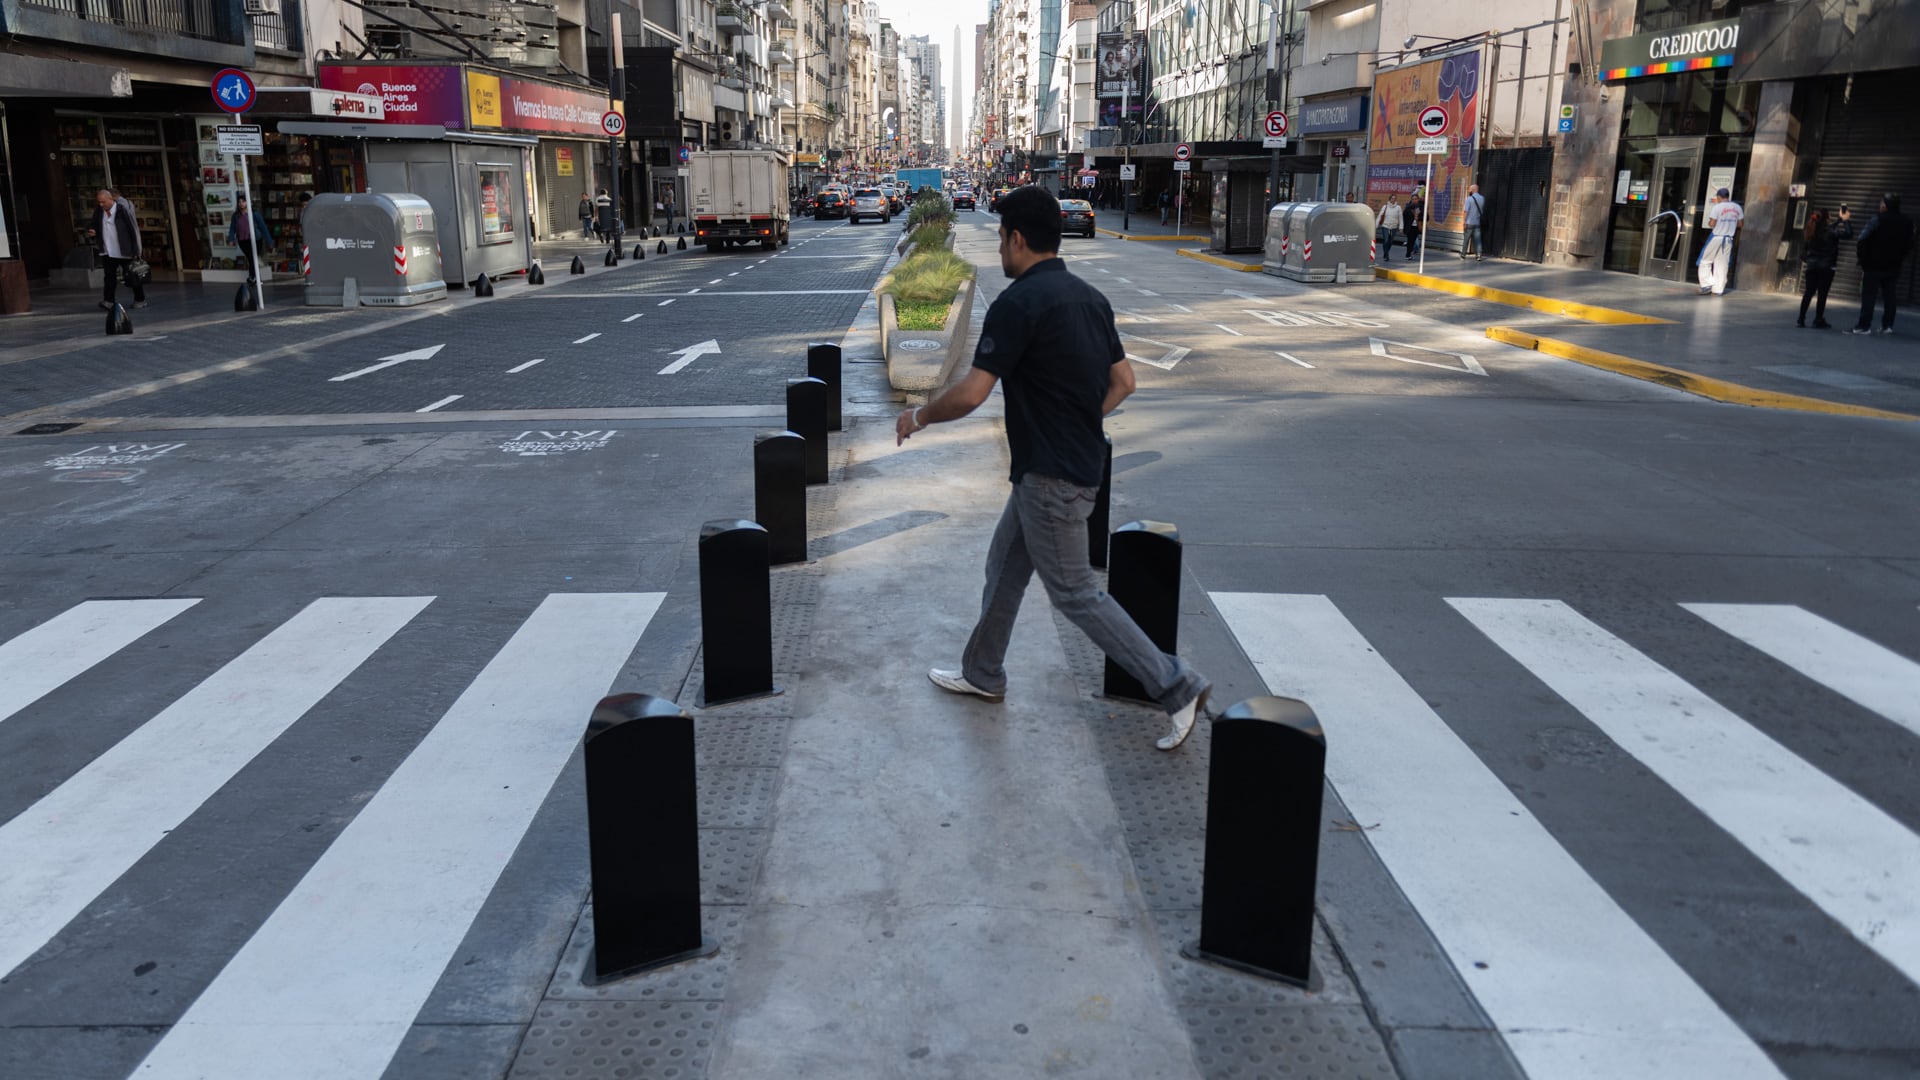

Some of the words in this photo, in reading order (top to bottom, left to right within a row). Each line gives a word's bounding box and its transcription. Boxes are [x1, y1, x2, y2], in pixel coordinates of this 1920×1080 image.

[1650, 25, 1739, 59] CREDICOO
[382, 83, 417, 92] Buenos
[383, 93, 408, 102] Aires
[384, 102, 417, 112] Ciudad
[513, 95, 541, 118] Vivamos
[541, 99, 547, 119] la
[547, 104, 564, 121] nueva
[564, 103, 577, 122] Calle
[577, 106, 601, 125] Corrientes
[606, 118, 621, 129] 40
[326, 238, 346, 249] BA
[1242, 309, 1391, 329] BUS
